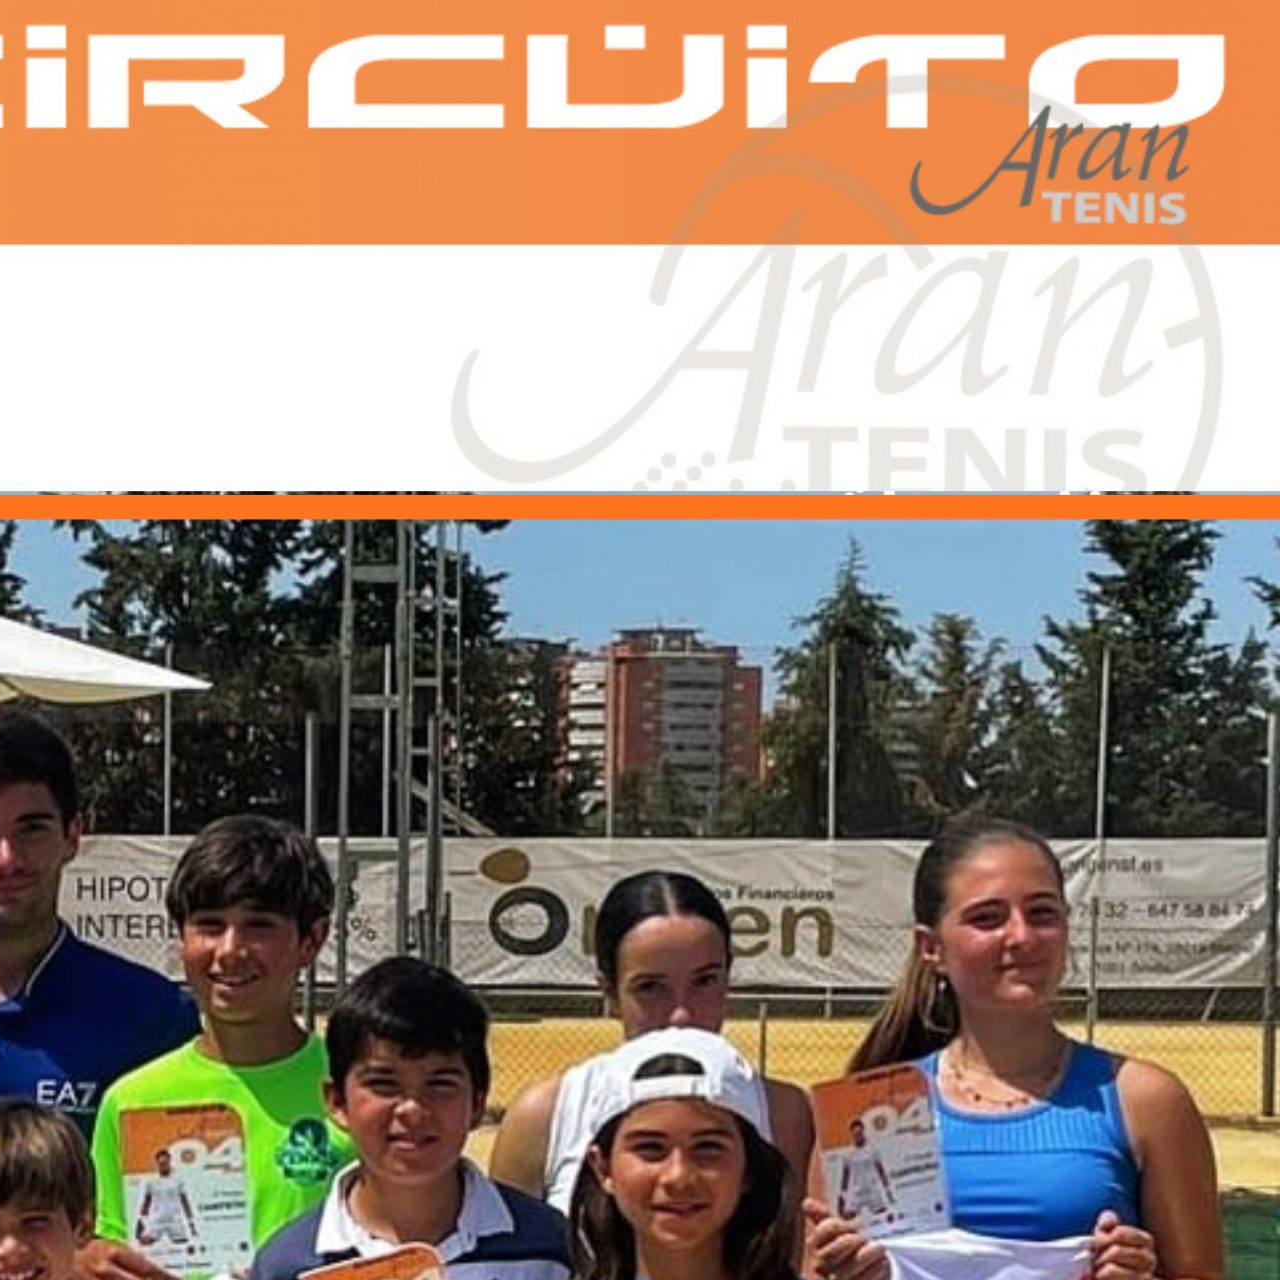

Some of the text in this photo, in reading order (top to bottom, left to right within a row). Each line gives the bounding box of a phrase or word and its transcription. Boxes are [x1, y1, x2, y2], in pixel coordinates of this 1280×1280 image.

[76, 876, 168, 902] HIPOT
[737, 886, 836, 901] Financieros
[36, 1079, 97, 1106] EA7
